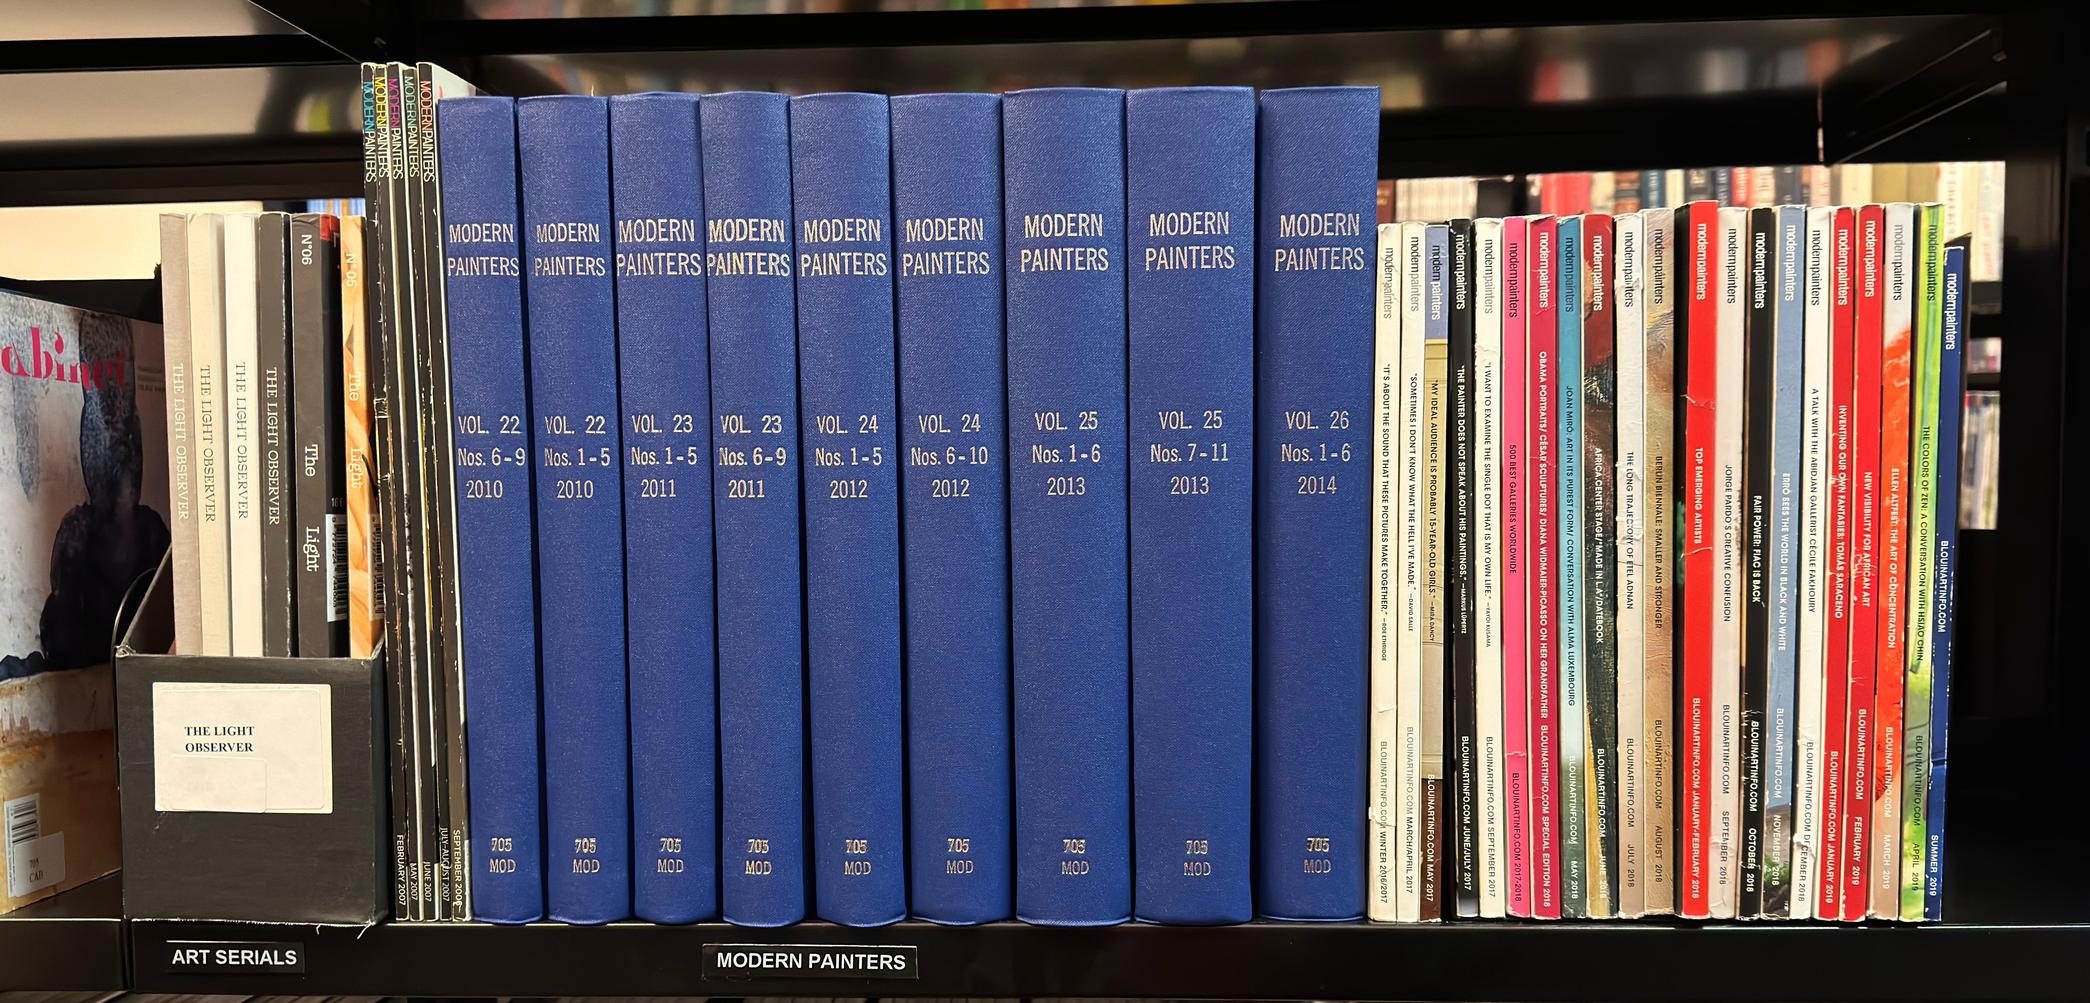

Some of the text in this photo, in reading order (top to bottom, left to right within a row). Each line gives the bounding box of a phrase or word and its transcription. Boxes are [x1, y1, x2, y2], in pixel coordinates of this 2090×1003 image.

[449, 223, 514, 244] MODERN
[536, 223, 600, 244] MODERN
[619, 219, 695, 243] MODERN
[708, 219, 785, 243] MODERN
[804, 219, 881, 242] MODERN
[906, 218, 984, 242] MODERN
[1024, 214, 1103, 238] MODERN
[1149, 211, 1229, 236] MODERN
[1280, 213, 1360, 237] MODERN
[448, 256, 519, 277] PAINTERS
[534, 257, 605, 276] PAINTERS
[617, 253, 701, 276] PAINTERS
[707, 253, 791, 277] PAINTERS
[801, 253, 887, 276] PAINTERS
[903, 251, 990, 276] PAINTERS
[1021, 248, 1109, 272] PAINTERS
[1145, 246, 1235, 270] PAINTERS
[1274, 248, 1364, 271] PAINTERS
[1538, 232, 1550, 308] modernpainters
[1696, 223, 1707, 300] modernpainters
[1810, 230, 1822, 305] modernpainters
[1864, 221, 1876, 297] modernpainters
[346, 271, 357, 287] 05
[1409, 237, 1420, 312] modernpainters
[1455, 234, 1467, 309] modernpainters
[1507, 243, 1519, 318] modernpainters
[1592, 235, 1604, 310] modernpainters
[1754, 232, 1766, 309] modernpainters
[1945, 273, 1958, 350] modernpainters
[349, 372, 360, 400] The
[458, 415, 522, 434] VOL. 22
[545, 415, 606, 434] VOL. 22
[632, 414, 693, 433] VOL. 23
[721, 415, 782, 434] VOL. 23
[816, 415, 879, 433] VOL. 24
[919, 414, 981, 433] VOL. 24
[1035, 411, 1099, 431] VOL. 25
[1159, 410, 1223, 430] VOL. 25
[1285, 411, 1349, 430] VOL. 26
[173, 363, 188, 520] THE LIGHT OBSERVER
[200, 365, 216, 522] THE LIGHT OBSERVER
[236, 362, 248, 519] THE LIGHT OBSERVER
[266, 367, 280, 525] THE LIGHT OBSERVER
[305, 444, 318, 476] The
[911, 446, 941, 465] Nos.
[1151, 444, 1182, 463] Nos.
[1695, 448, 1703, 464] TOP
[348, 447, 364, 488] Light
[1724, 465, 1732, 492] JORGE
[466, 480, 504, 499] 2010
[556, 480, 594, 499] 2010
[640, 479, 676, 498] 2011
[728, 480, 765, 498] 2011
[830, 480, 868, 498] 2012
[932, 479, 970, 498] 2012
[1047, 477, 1085, 496] 2013
[1170, 476, 1209, 495] 2013
[1298, 476, 1337, 495] 2014
[1864, 472, 1872, 491] NEW
[1724, 494, 1732, 530] PARDO'S
[1753, 496, 1761, 514] FAIR
[1864, 493, 1872, 532] VISIBILITY
[1694, 513, 1702, 543] ARTISTS
[1753, 516, 1761, 547] POWER:
[303, 527, 320, 571] Light
[1724, 533, 1732, 570] CREATIVE
[1753, 549, 1761, 568] FIAC
[1862, 553, 1871, 589] AFRICAN
[1752, 580, 1760, 602] BACK
[1862, 591, 1870, 607] ART
[185, 726, 254, 736] THE LIGHT
[1692, 698, 1700, 788] BLOUINARTINFO.COM
[185, 742, 253, 752] OBSERVER
[1406, 726, 1414, 814] BLOUINARTINFO.COM
[1462, 736, 1470, 824] BLOUINARTINFO.COM
[1852, 709, 1866, 885] BLOUINARTINFO.COM FEBRUARY 2019
[1513, 773, 1521, 860] BLOUINARTINFO.COM
[1825, 751, 1838, 903] BLOUINARTINFO.COM JANUARY 2019
[659, 837, 681, 853] 705
[948, 839, 969, 853] 705
[1691, 791, 1700, 877] JANUARY-FEBRUARY
[397, 835, 405, 881] FEBRUARY
[1463, 826, 1471, 870] JUNE/JULY
[1930, 835, 1938, 873] SUMMER
[657, 858, 683, 873] MOD
[946, 859, 974, 875] MOD
[172, 950, 297, 965] ART SERIALS
[717, 952, 906, 970] MODERN PAINTERS
